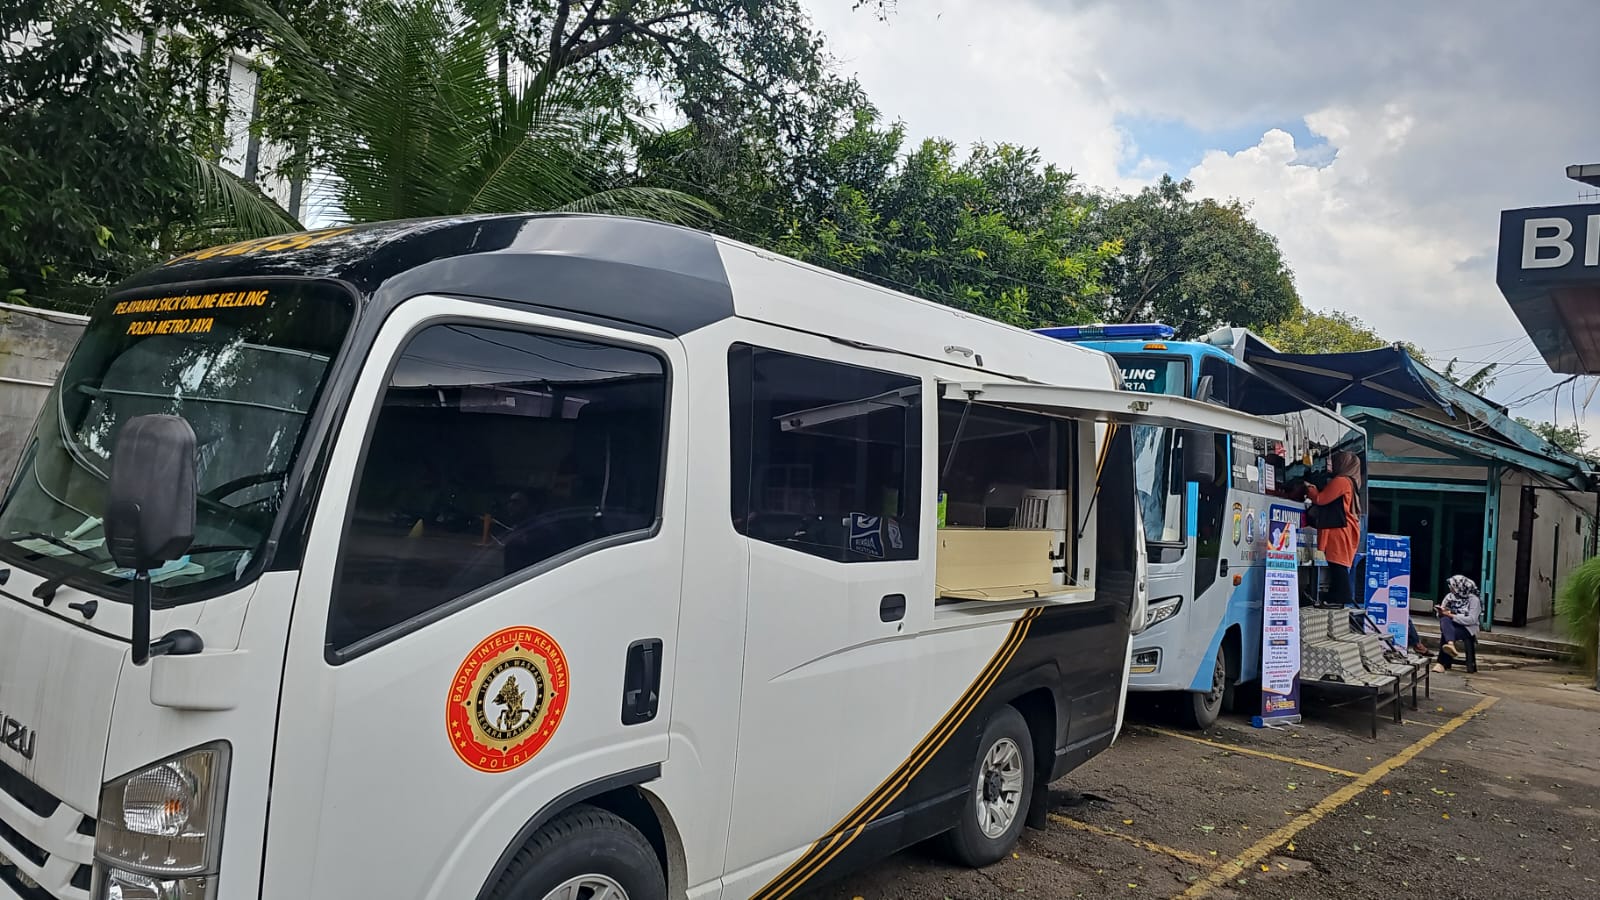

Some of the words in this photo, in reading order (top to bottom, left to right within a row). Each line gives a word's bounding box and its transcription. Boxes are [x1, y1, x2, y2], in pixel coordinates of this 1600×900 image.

[112, 298, 161, 315] PELAYANAN
[157, 296, 183, 310] SKCK
[180, 293, 220, 309] ONLINE
[217, 290, 269, 308] KELILING
[126, 321, 157, 335] POLDA
[156, 318, 189, 334] METRO
[187, 317, 215, 333] JAYA
[1370, 549, 1389, 557] TARIF
[1389, 550, 1407, 559] BARU
[453, 659, 478, 702] BADAN
[477, 632, 531, 659] INTELIJEN
[533, 635, 565, 688] KEAMANAN
[479, 750, 528, 768] POLRI
